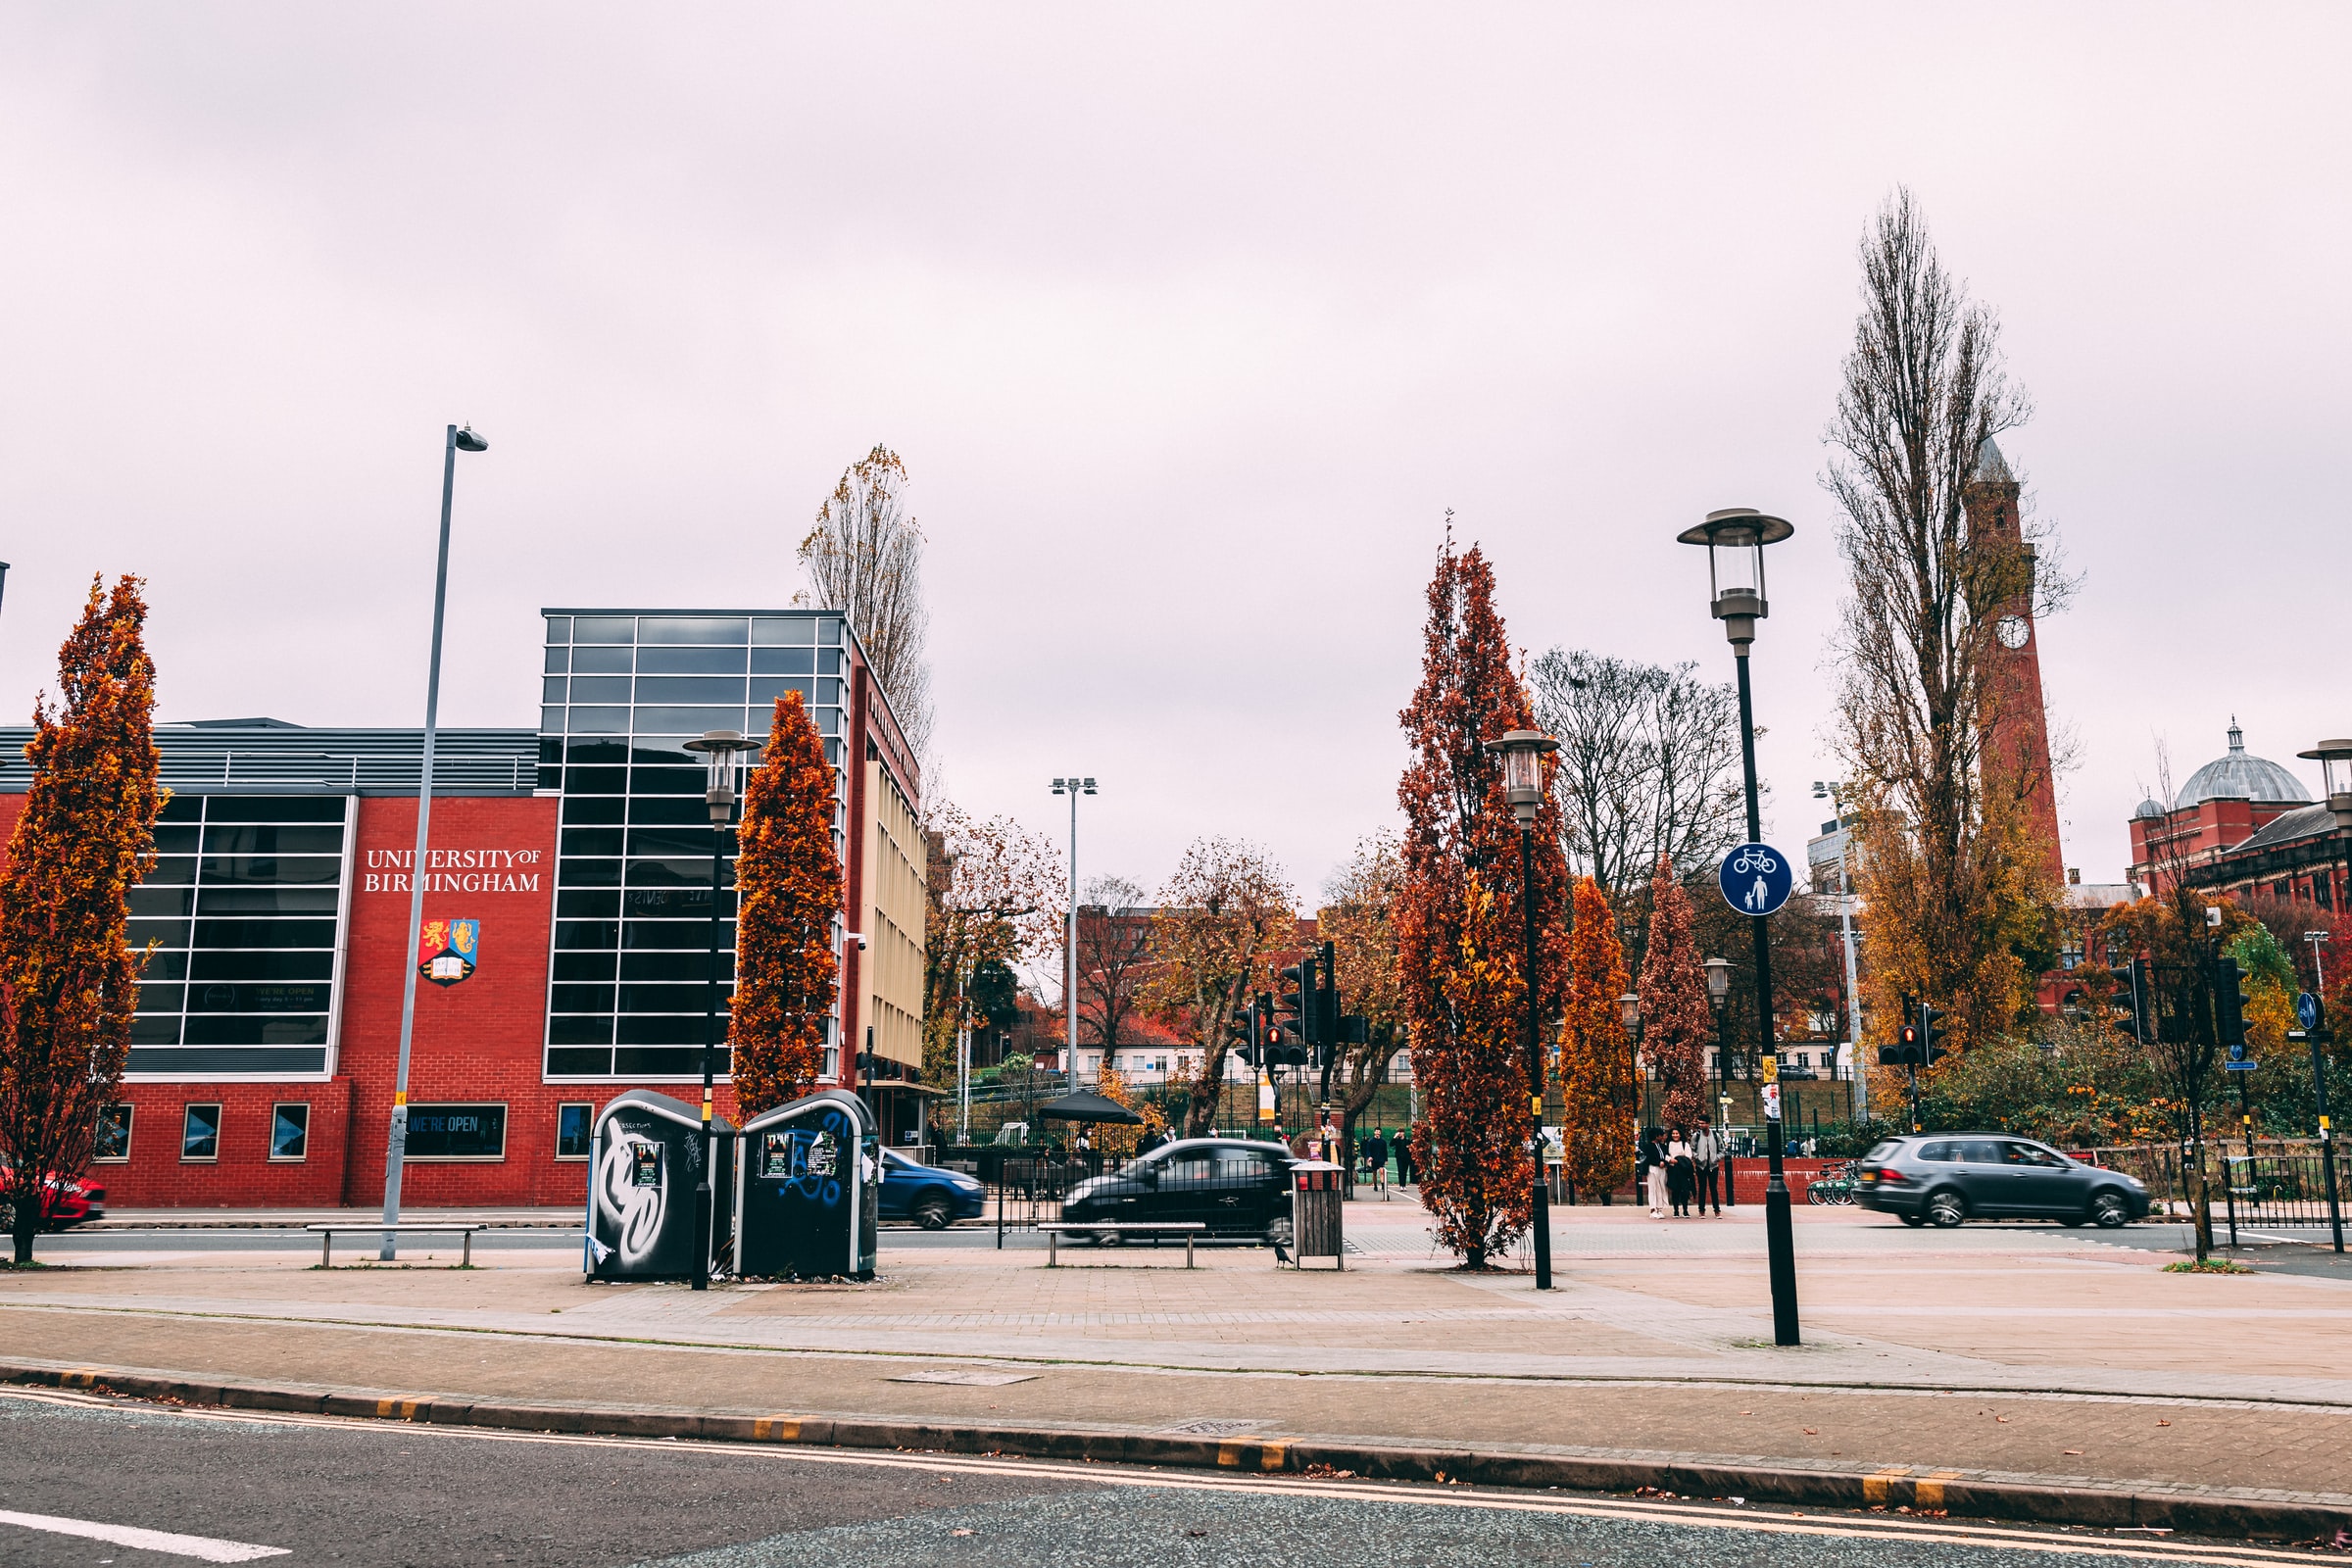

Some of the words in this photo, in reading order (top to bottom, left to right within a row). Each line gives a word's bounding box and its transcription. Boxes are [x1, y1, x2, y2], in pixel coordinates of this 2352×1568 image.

[368, 850, 514, 868] UNIERSITY
[518, 850, 541, 863] OF
[288, 987, 315, 996] OPEN
[410, 1116, 445, 1132] WE'RE
[448, 1116, 478, 1132] OPEN
